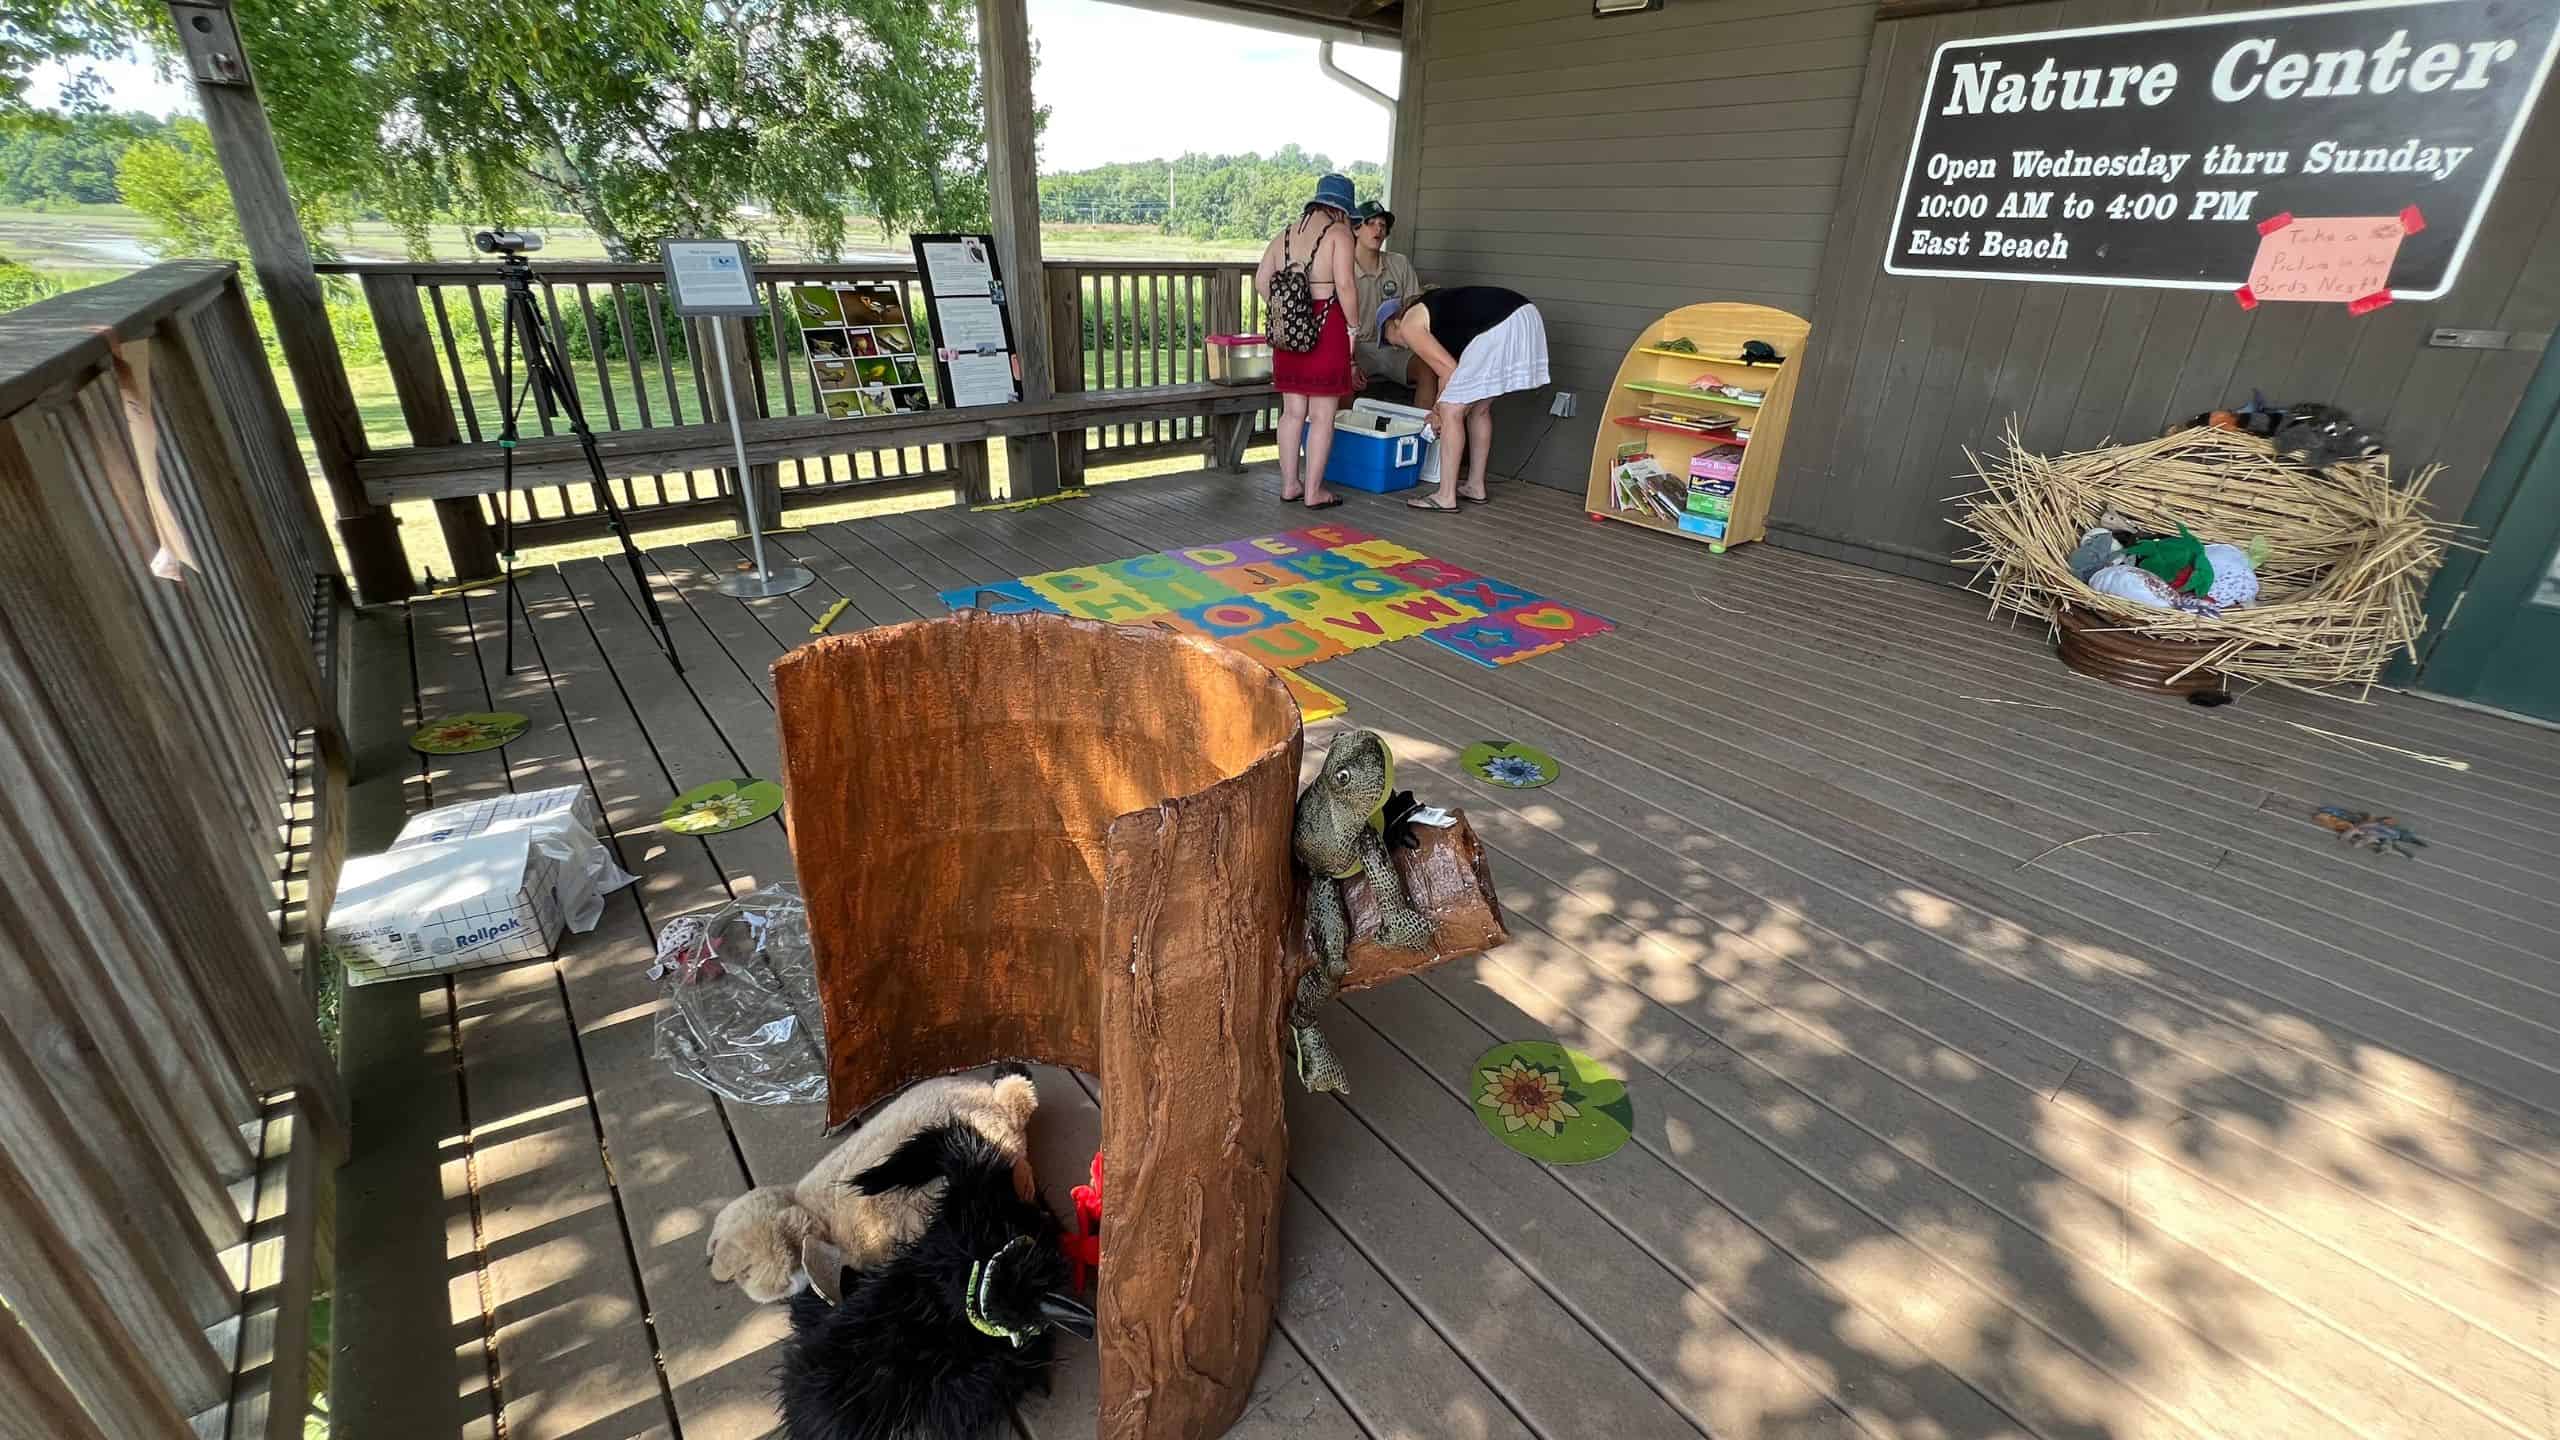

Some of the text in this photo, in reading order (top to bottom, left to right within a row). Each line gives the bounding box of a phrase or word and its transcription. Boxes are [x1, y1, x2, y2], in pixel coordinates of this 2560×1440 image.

[1942, 29, 2518, 116] Nature Center
[1927, 138, 2474, 186] Open Wednesday thru Sunday
[1917, 190, 2259, 221] 10:00 AM to 4:00 PM
[1907, 229, 2069, 259] East Beach
[2289, 229, 2359, 245] Take a
[1122, 558, 1177, 577] C
[1183, 549, 1238, 566] D
[1251, 538, 1298, 554] E
[1307, 527, 1344, 544] F
[1075, 593, 1149, 619] H
[1243, 567, 1280, 585] J
[1288, 555, 1350, 576] K
[1203, 604, 1265, 628] O
[1272, 589, 1321, 610] P
[1249, 628, 1321, 657] U
[1322, 611, 1385, 635] V
[1385, 596, 1463, 622] W
[456, 918, 520, 947] Rollpak
